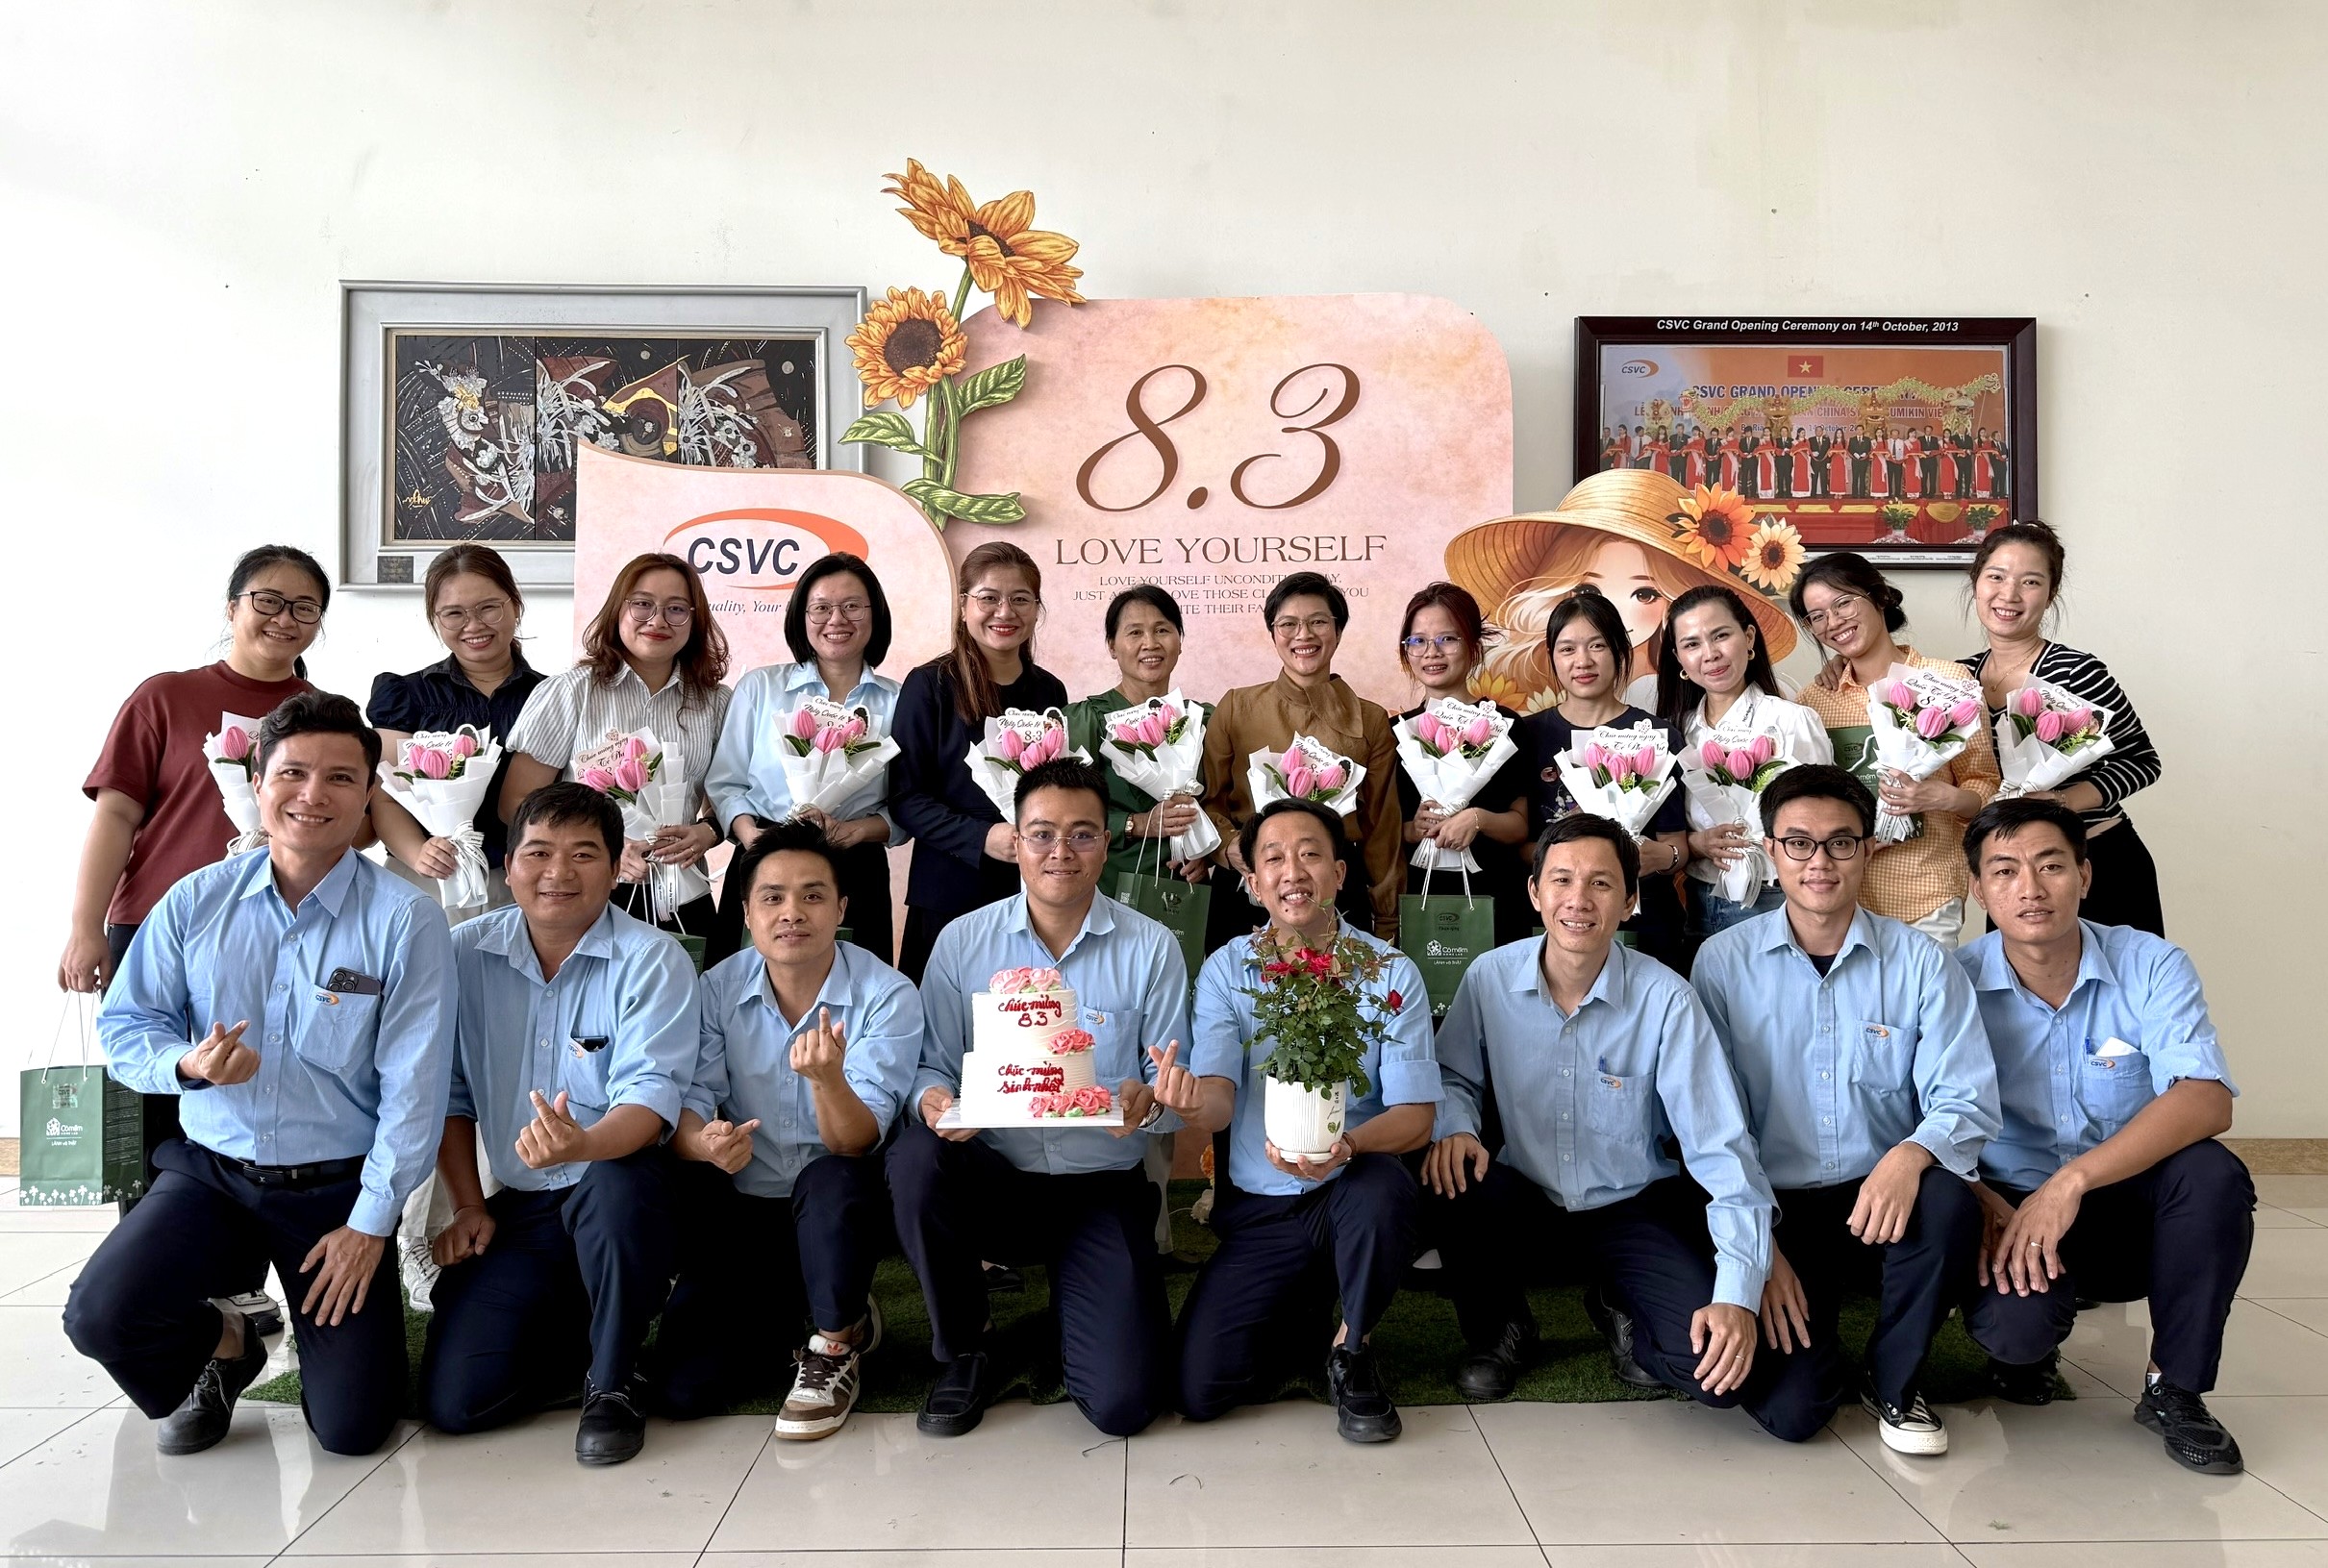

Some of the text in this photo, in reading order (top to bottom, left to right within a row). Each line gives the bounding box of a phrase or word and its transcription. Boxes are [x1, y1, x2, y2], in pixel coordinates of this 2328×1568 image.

[1657, 320, 1690, 330] CSVC
[1693, 320, 1728, 331] Grand
[1731, 320, 1779, 333] Opening
[1782, 321, 1839, 333] Ceremony
[1860, 321, 1879, 332] 14th
[1882, 322, 1929, 333] October,
[1932, 322, 1959, 332] 2013
[1730, 386, 1775, 398] GRAND
[1817, 407, 1847, 416] CHINA
[1890, 408, 1925, 417] UMIKIN
[1076, 363, 1361, 511] 8.3
[688, 537, 800, 576] CSVC
[1056, 535, 1388, 565] LOVE YOURSELF
[1100, 576, 1136, 585] LOVE
[1140, 575, 1211, 585] YOURSELF
[1073, 590, 1105, 601] JUST
[1171, 590, 1200, 600] OVE
[1203, 588, 1248, 599] THOSE
[1340, 587, 1369, 598] YOU
[709, 600, 745, 615] uality,
[753, 601, 782, 612] Your
[1206, 604, 1243, 613] THEIR
[1024, 731, 1042, 741] 8-3
